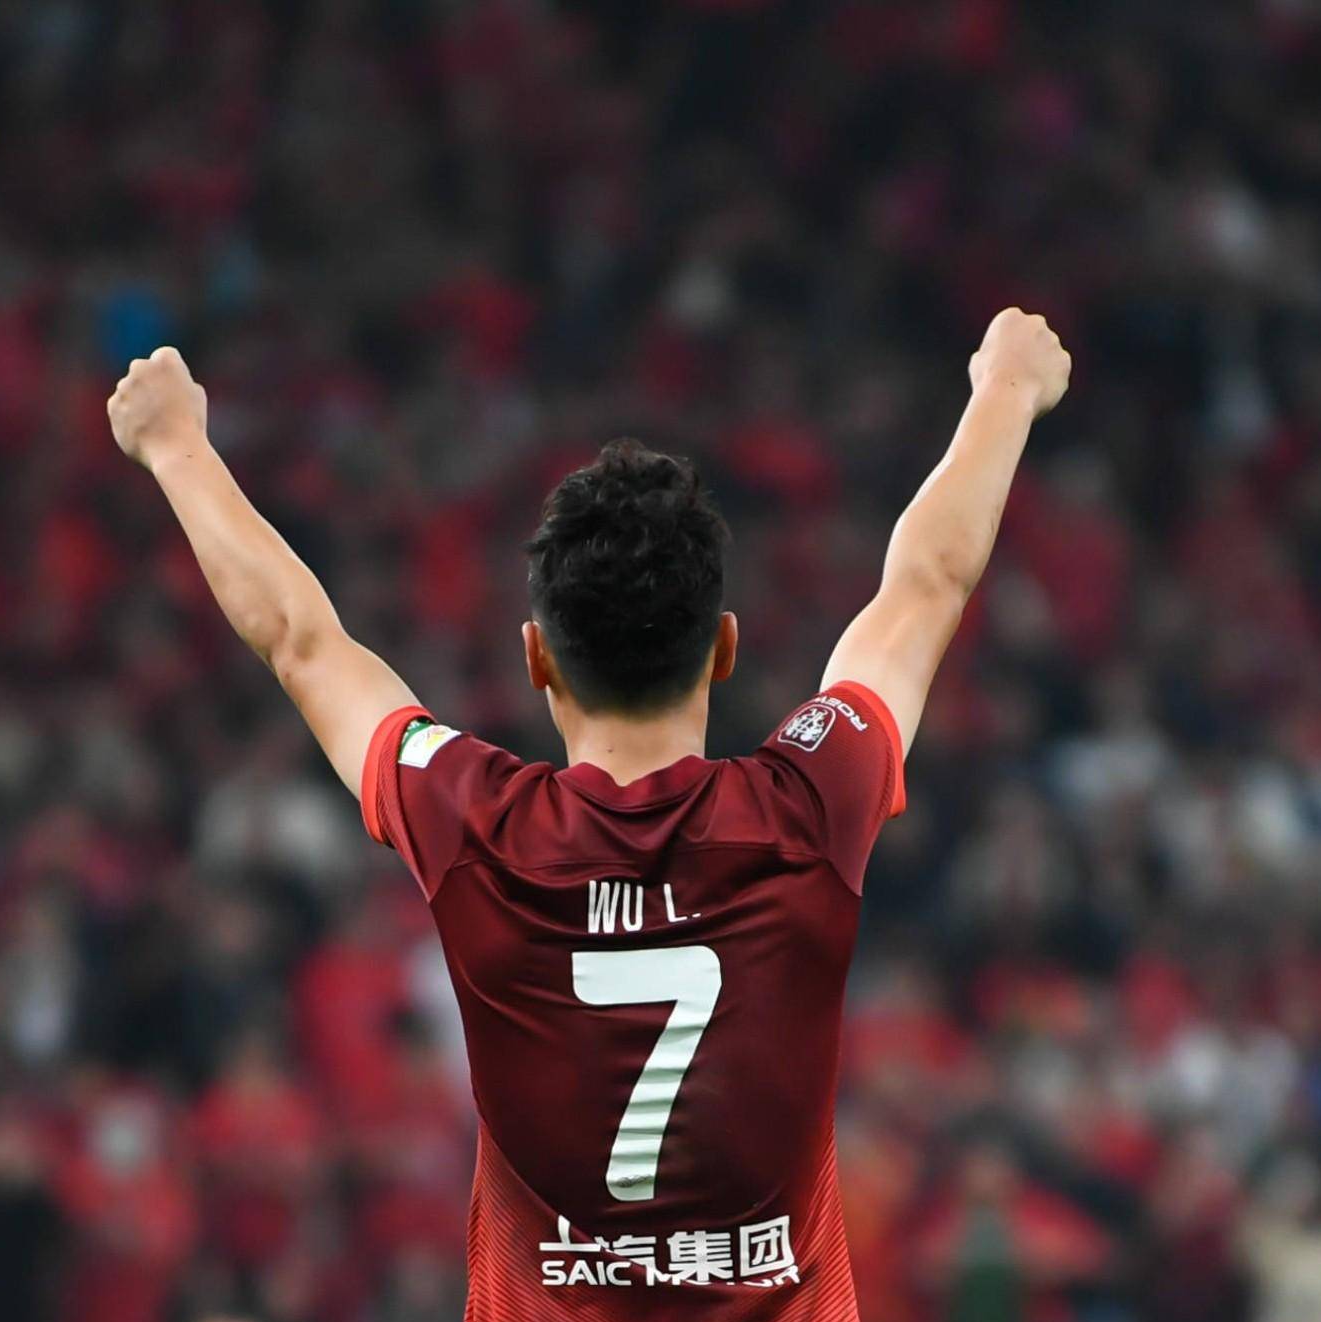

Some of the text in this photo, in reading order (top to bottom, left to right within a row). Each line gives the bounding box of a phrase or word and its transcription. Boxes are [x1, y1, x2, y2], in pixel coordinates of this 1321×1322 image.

[587, 879, 644, 934] WU
[571, 944, 722, 1202] 7
[541, 1259, 632, 1287] SAIC
